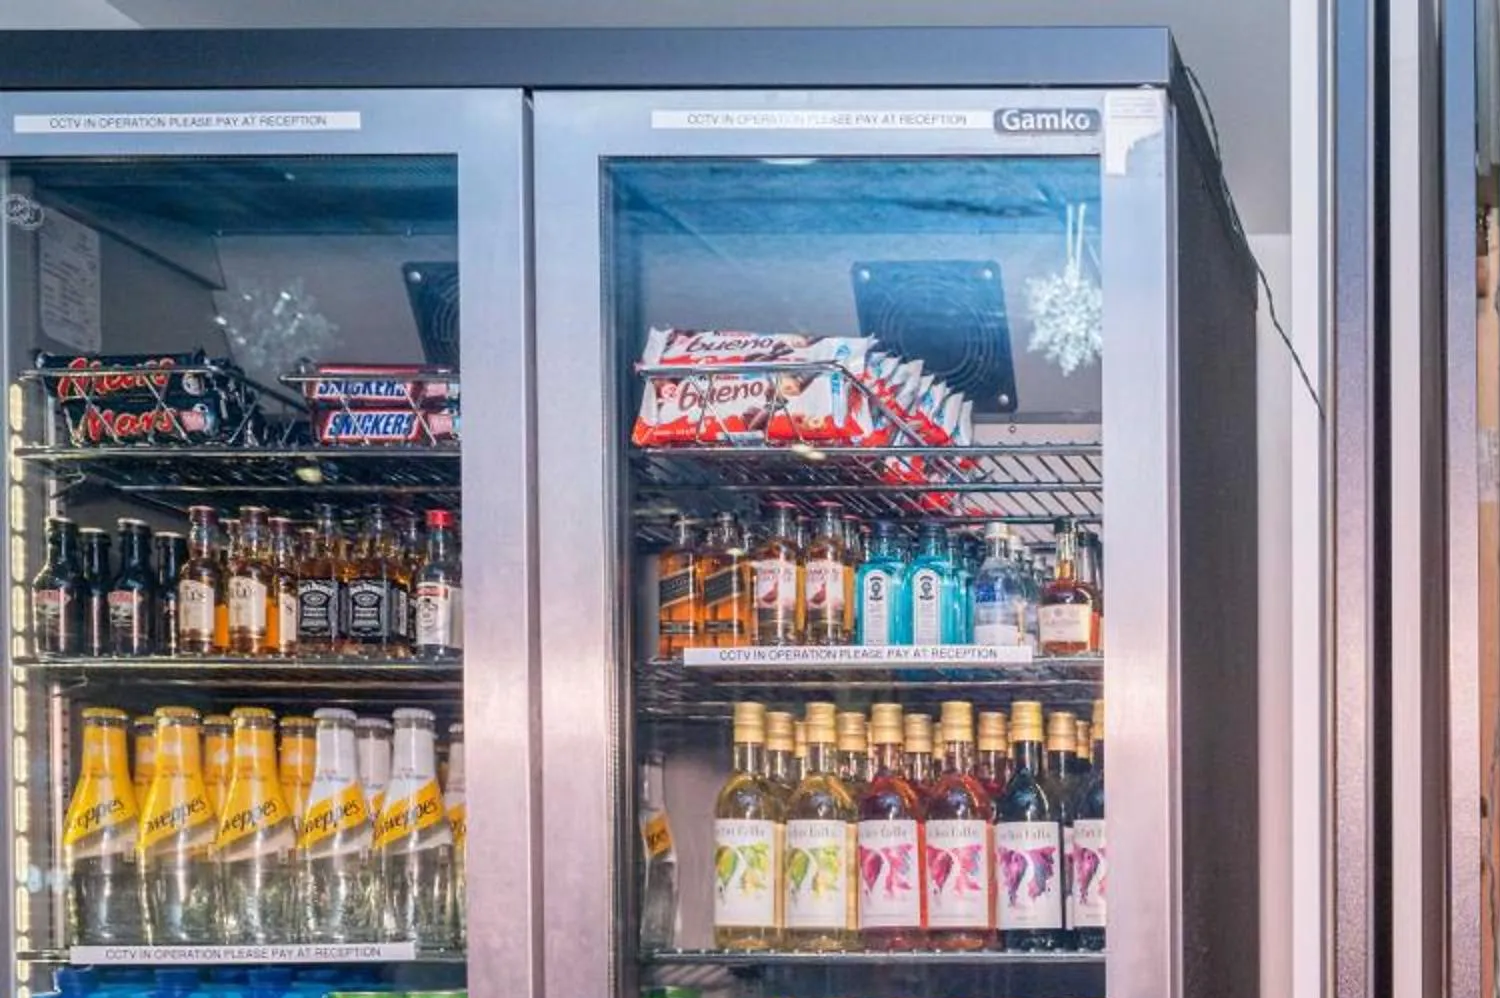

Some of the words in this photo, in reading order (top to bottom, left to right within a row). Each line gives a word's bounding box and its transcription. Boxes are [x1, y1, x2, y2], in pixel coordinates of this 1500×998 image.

[50, 117, 80, 129] CCTV
[83, 117, 96, 129] IN
[100, 116, 166, 128] OPERATION
[169, 116, 213, 128] PLEASE
[217, 116, 239, 128] PAY
[241, 116, 256, 128] AT
[260, 115, 327, 127] RECEPTION
[1002, 109, 1090, 131] Gamko
[686, 337, 773, 353] bueno
[678, 379, 763, 411] bueno
[86, 407, 176, 441] Mars
[329, 413, 416, 436] SNICKERS
[719, 650, 750, 662] CCTV
[754, 650, 766, 662] IN
[769, 649, 836, 661] OPERATION
[839, 648, 884, 661] PLEASE
[887, 648, 909, 661] PAY
[913, 648, 927, 661] AT
[931, 647, 998, 660] RECEPTION
[105, 949, 137, 961] CCTV
[139, 949, 151, 961] IN
[154, 948, 221, 960] OPERATION
[223, 947, 268, 959] PLEASE
[271, 947, 294, 959] PAY
[296, 947, 312, 959] AT
[315, 946, 381, 958] RECEPTION
